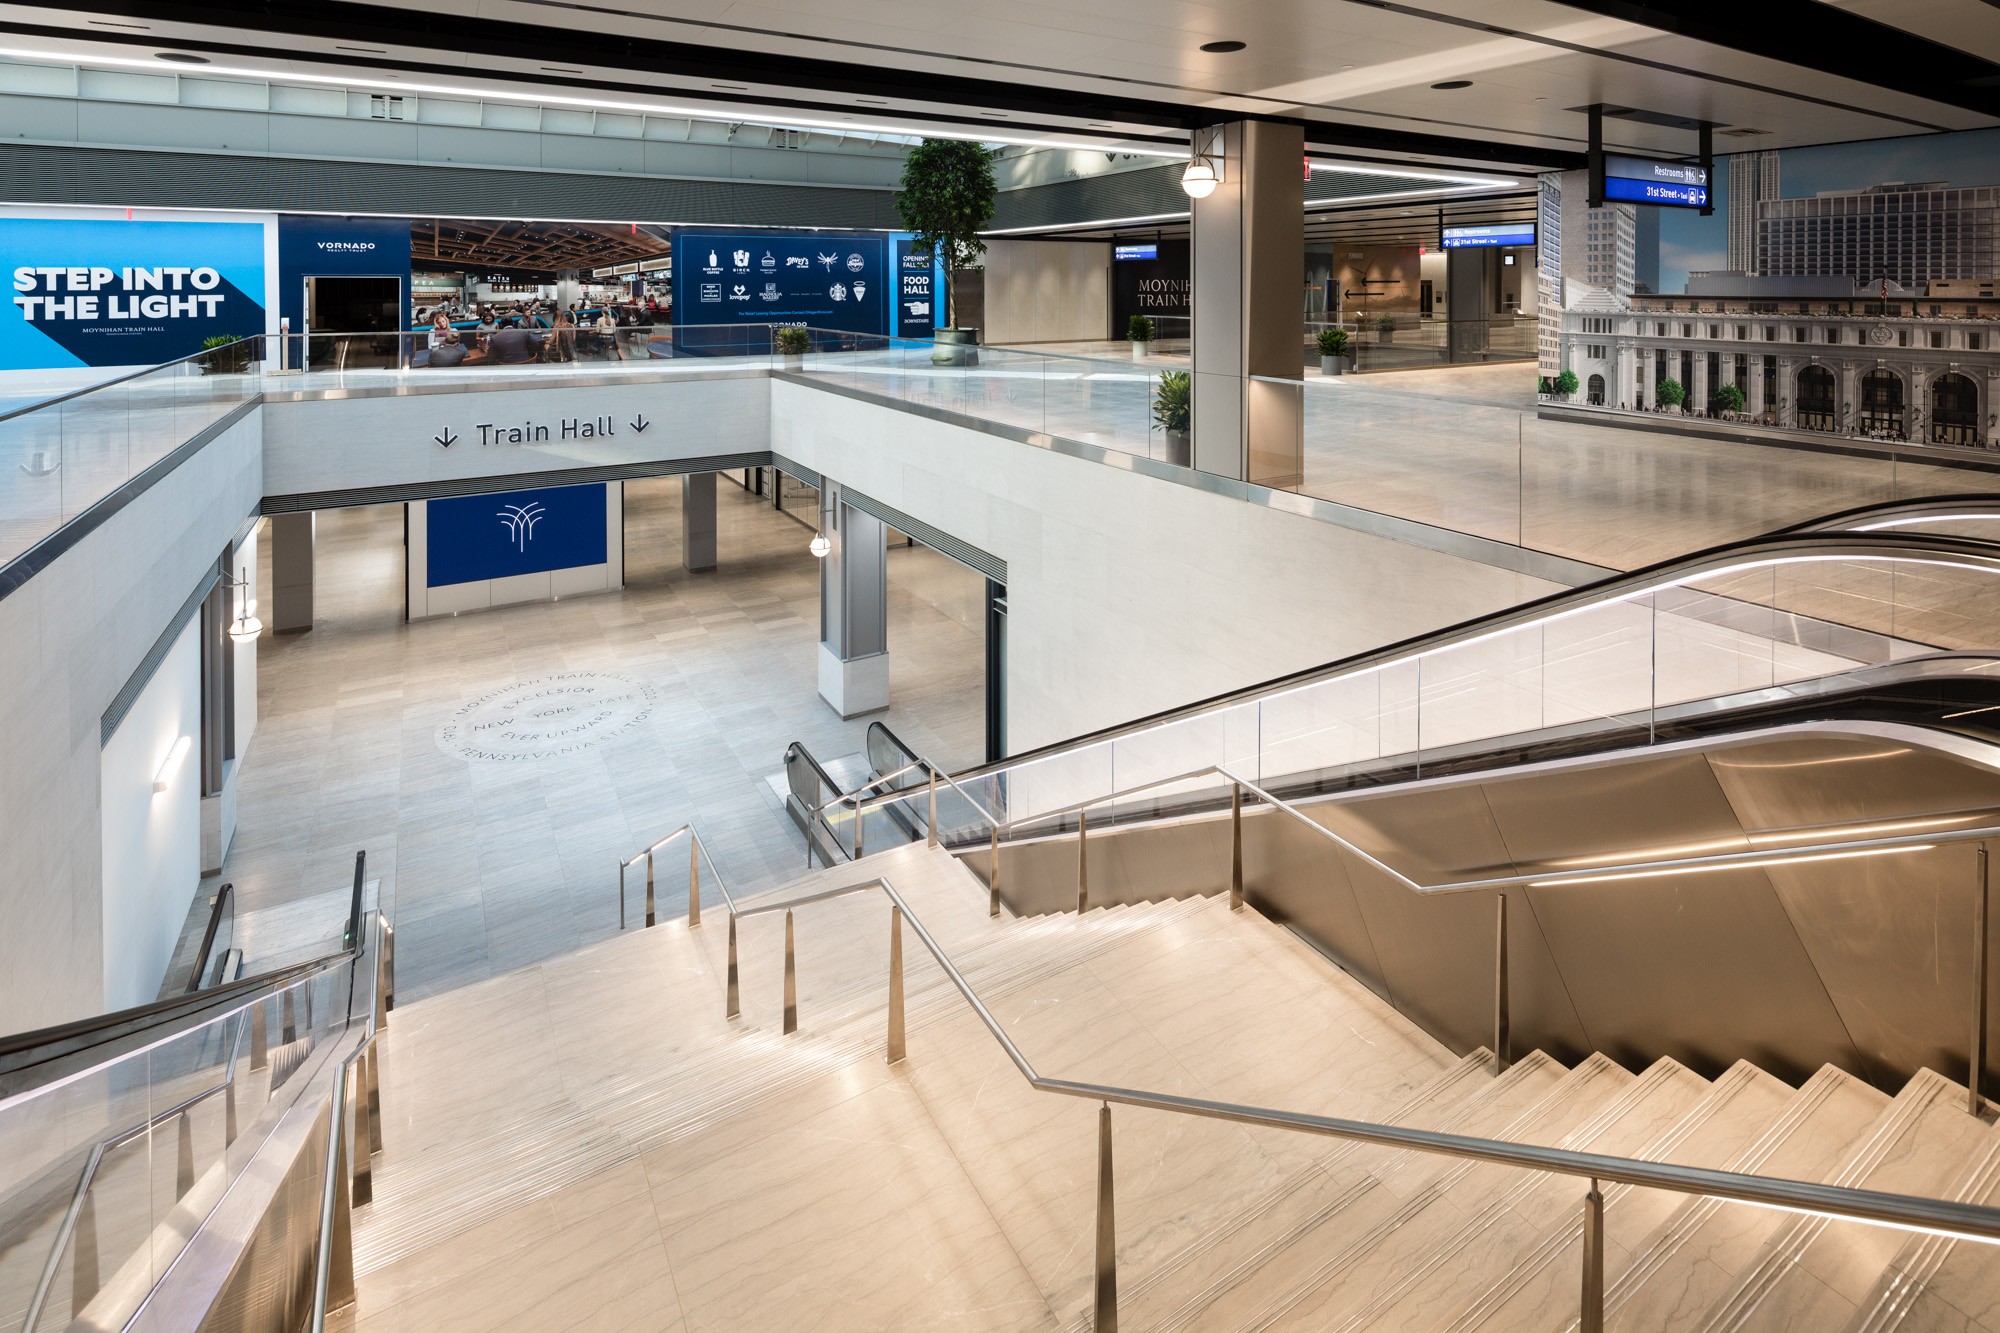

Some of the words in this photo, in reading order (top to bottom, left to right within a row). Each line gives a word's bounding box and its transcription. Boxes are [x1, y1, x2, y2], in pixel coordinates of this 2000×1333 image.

[1654, 165, 1684, 178] Restrooms
[1646, 186, 1660, 197] 31st
[1660, 187, 1677, 199] Street
[13, 266, 114, 292] STEP
[122, 266, 221, 291] INTO
[904, 276, 929, 285] FOOD
[1138, 279, 1190, 292] MOYNIH
[904, 285, 929, 294] HALL
[13, 295, 100, 321] THE
[108, 294, 225, 319] LIGHT
[1137, 294, 1178, 307] TRAIN
[476, 421, 550, 446] Train
[561, 415, 615, 440] Hall
[547, 672, 596, 681] TRAIN
[600, 673, 633, 682] HALL
[503, 687, 595, 710] EXCELSIOR
[474, 718, 514, 731] NEW
[533, 706, 576, 718] YORK
[587, 694, 633, 708] STATE
[458, 742, 595, 761] PENNSYLVANIA
[600, 708, 652, 740] STATION
[500, 731, 540, 741] EVER
[547, 710, 612, 739] UPWARD
